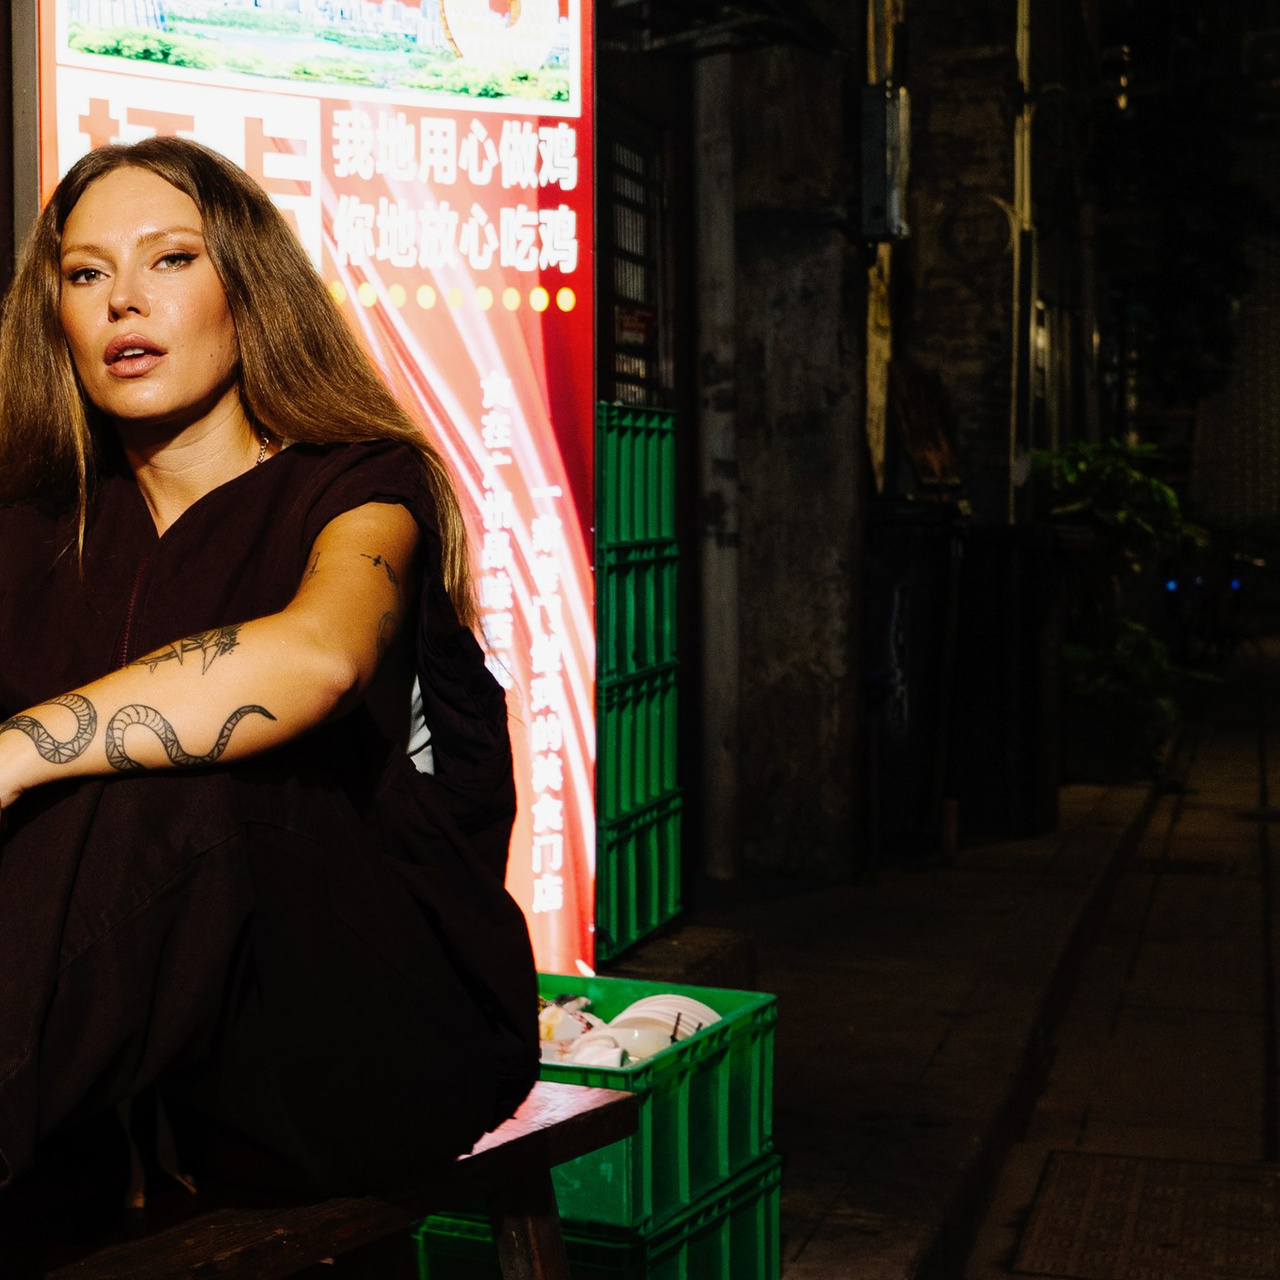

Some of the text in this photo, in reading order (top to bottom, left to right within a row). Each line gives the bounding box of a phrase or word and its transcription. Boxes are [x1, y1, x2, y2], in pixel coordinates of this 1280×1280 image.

[331, 108, 578, 191] 我地用心做鸡
[331, 194, 578, 274] 你地放心吃鸡
